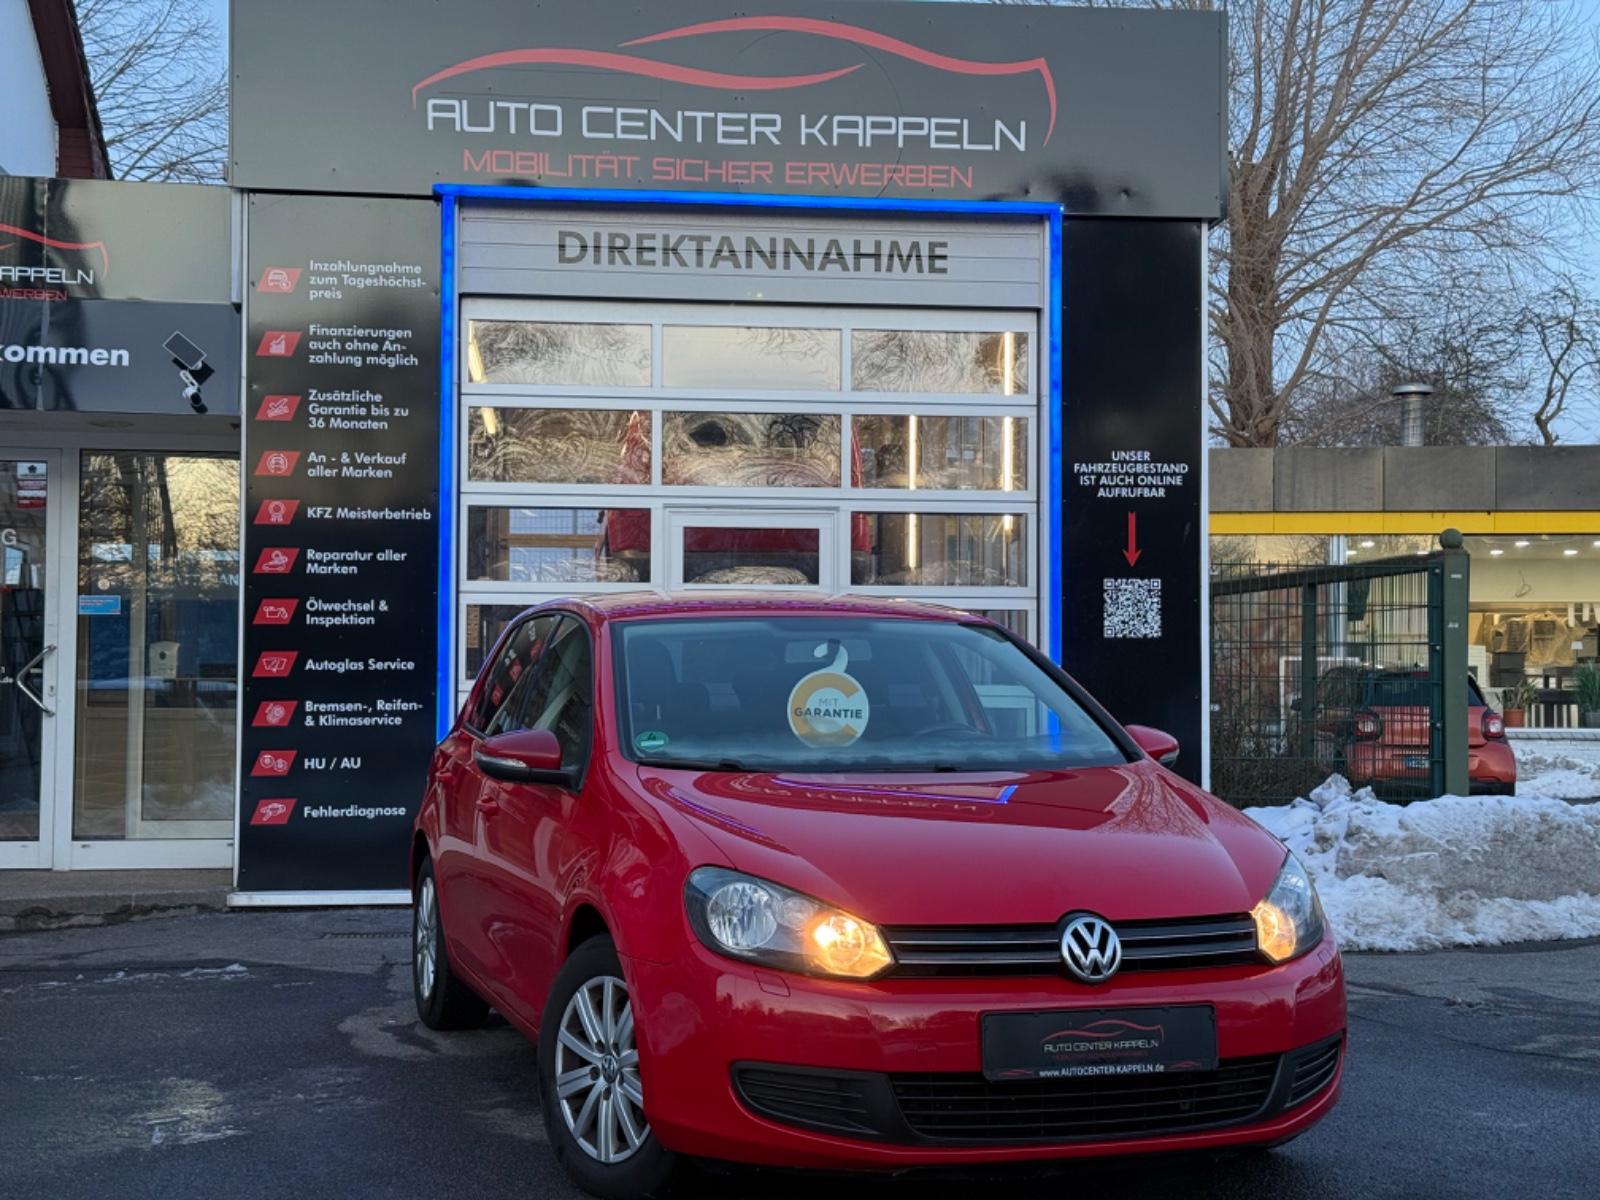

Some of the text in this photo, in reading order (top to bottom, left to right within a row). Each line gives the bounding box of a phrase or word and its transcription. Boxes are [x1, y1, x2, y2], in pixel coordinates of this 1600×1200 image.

[427, 98, 1027, 152] AUTO CENTER KAPPELN
[463, 149, 974, 189] MOBILITÄT SICHER ERWERBEN
[557, 230, 948, 275] DIREKTANNAHME
[309, 260, 422, 275] Inzahlungnahme
[309, 273, 427, 289] zum Tageshöchst-
[309, 288, 343, 301] preis
[308, 325, 412, 340] Finanzierungen
[308, 339, 407, 351] auch ohne An-
[308, 353, 419, 368] zahlung möglich
[308, 389, 383, 401] Zusätzliche
[308, 404, 409, 417] Garantie bis zu
[308, 417, 388, 430] 36 Monaten
[340, 453, 350, 463] &
[354, 453, 407, 465] Verkauf
[1111, 451, 1151, 461] UNSER
[307, 466, 393, 478] aller Marken
[1074, 463, 1189, 474] FAHRZEUGBESTAND
[1080, 475, 1183, 486] IST AUCH ONLINE
[1097, 487, 1166, 498] AUFRUFBAR
[307, 507, 432, 520] KFZ Meisterbetrieb
[306, 549, 407, 563] Reparatur aller
[306, 563, 358, 575] Marken
[305, 597, 389, 612] Ölwechsel &
[305, 613, 375, 628] Inspektion
[304, 658, 415, 673] Autoglas Service
[305, 699, 423, 713] Bremsen-, Reifen-
[818, 698, 839, 707] MIT
[794, 706, 863, 719] GARANTIE
[304, 714, 402, 727] & Klimaservice
[304, 757, 362, 770] HU / AU
[303, 805, 407, 819] Fehlerdiagnose
[1044, 1039, 1159, 1053] AUTO CENTER KAPPELN
